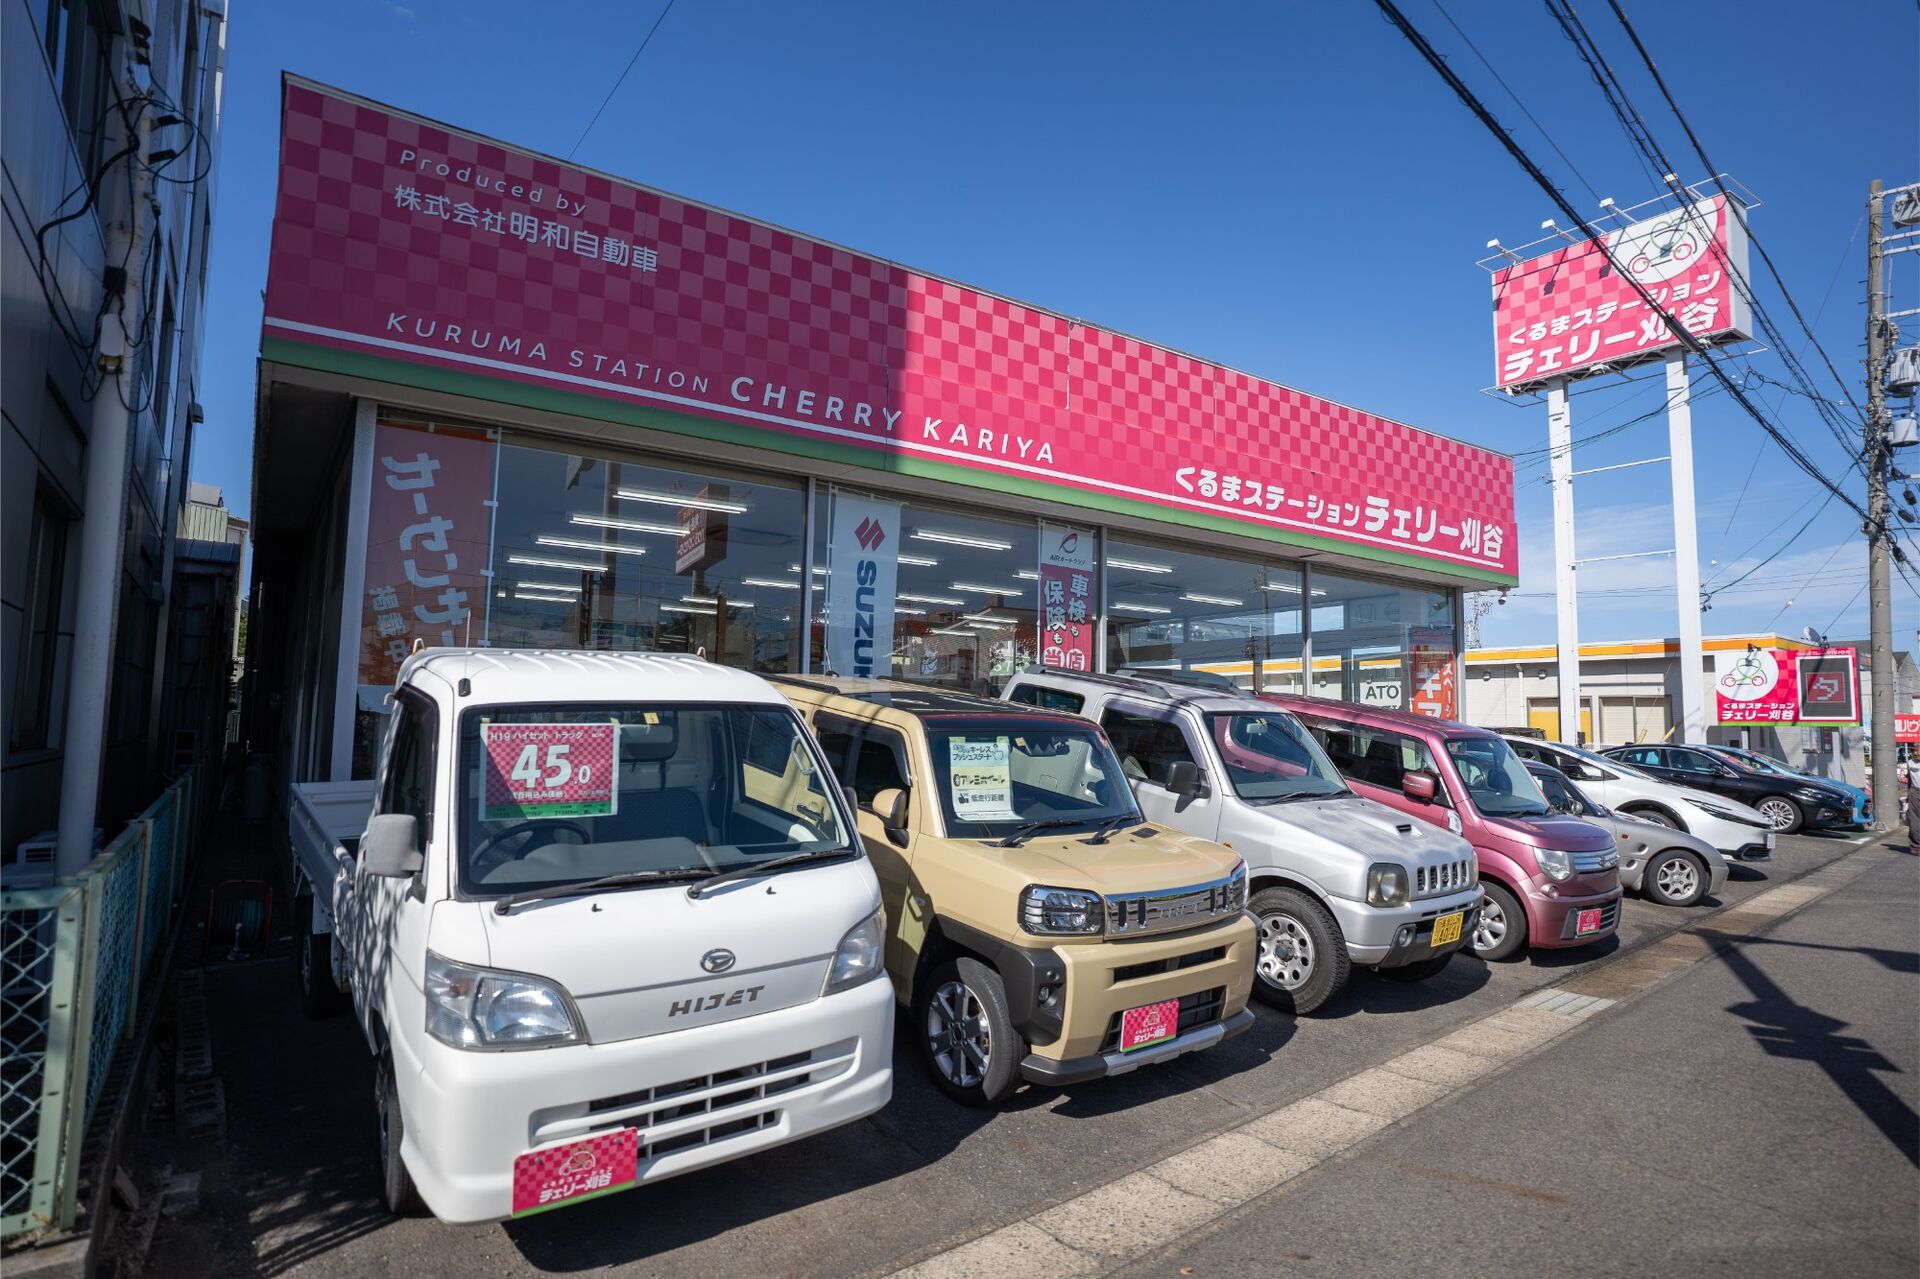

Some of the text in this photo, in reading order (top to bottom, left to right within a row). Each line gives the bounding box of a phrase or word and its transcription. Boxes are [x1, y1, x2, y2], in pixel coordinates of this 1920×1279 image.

[400, 150, 587, 217] Produced by
[394, 184, 659, 273] 株式会社明和自動車
[1504, 298, 1719, 381] チェリー刈谷
[1508, 271, 1721, 344] くるまステーション
[387, 312, 1054, 464] KURUMA STATION CHERRY KARIYA
[1044, 580, 1067, 644] 保険も
[1068, 574, 1090, 636] 車検も
[1443, 663, 1453, 718] スペーシ
[1722, 710, 1795, 720] チェリー刈谷
[669, 985, 765, 1017] HIJET
[539, 1172, 612, 1203] チェリー刈谷
